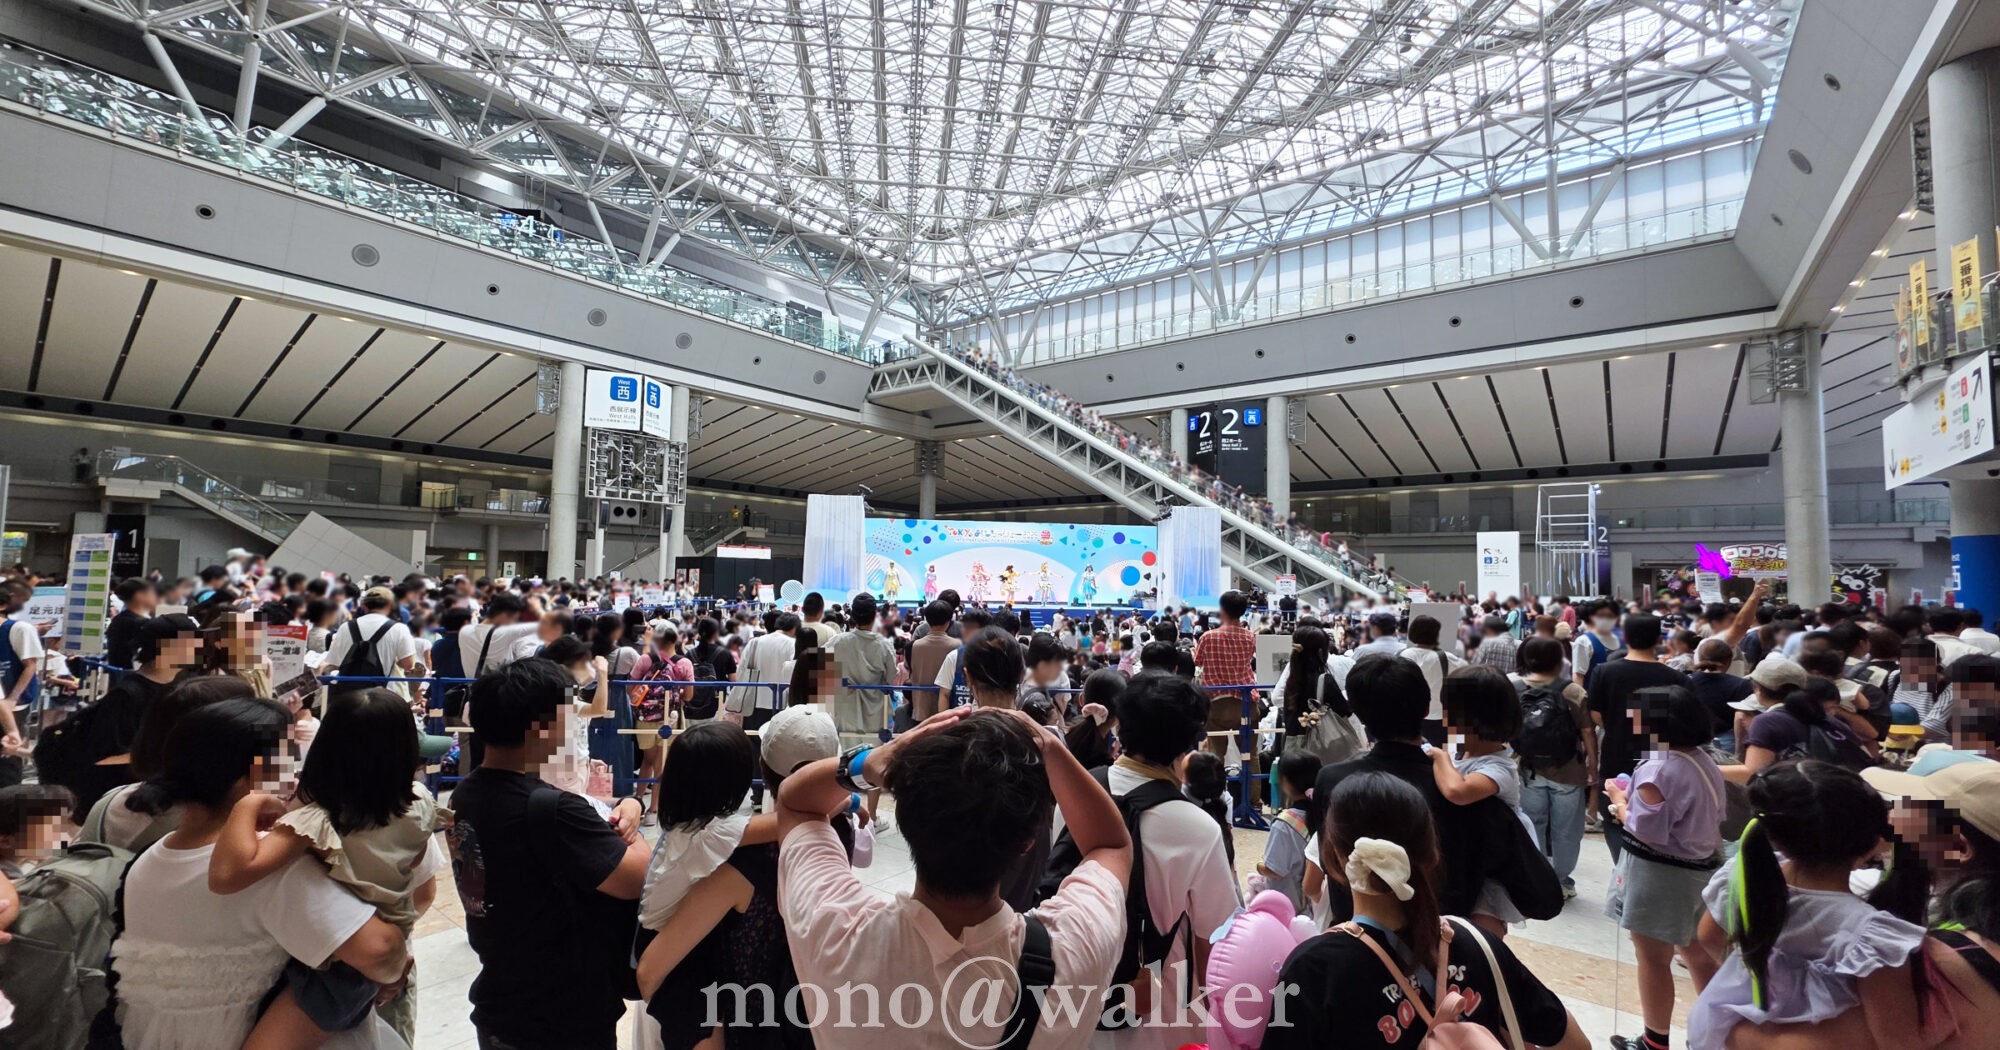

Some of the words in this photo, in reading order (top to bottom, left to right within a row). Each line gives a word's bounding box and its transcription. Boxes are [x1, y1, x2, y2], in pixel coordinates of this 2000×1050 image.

[519, 215, 536, 237] 4
[1959, 257, 1972, 300] 一番搾り
[617, 386, 630, 399] 西
[649, 391, 657, 405] 西
[1200, 411, 1212, 438] 2
[1221, 409, 1239, 434] 2
[128, 529, 138, 549] 1
[1598, 527, 1608, 543] 2
